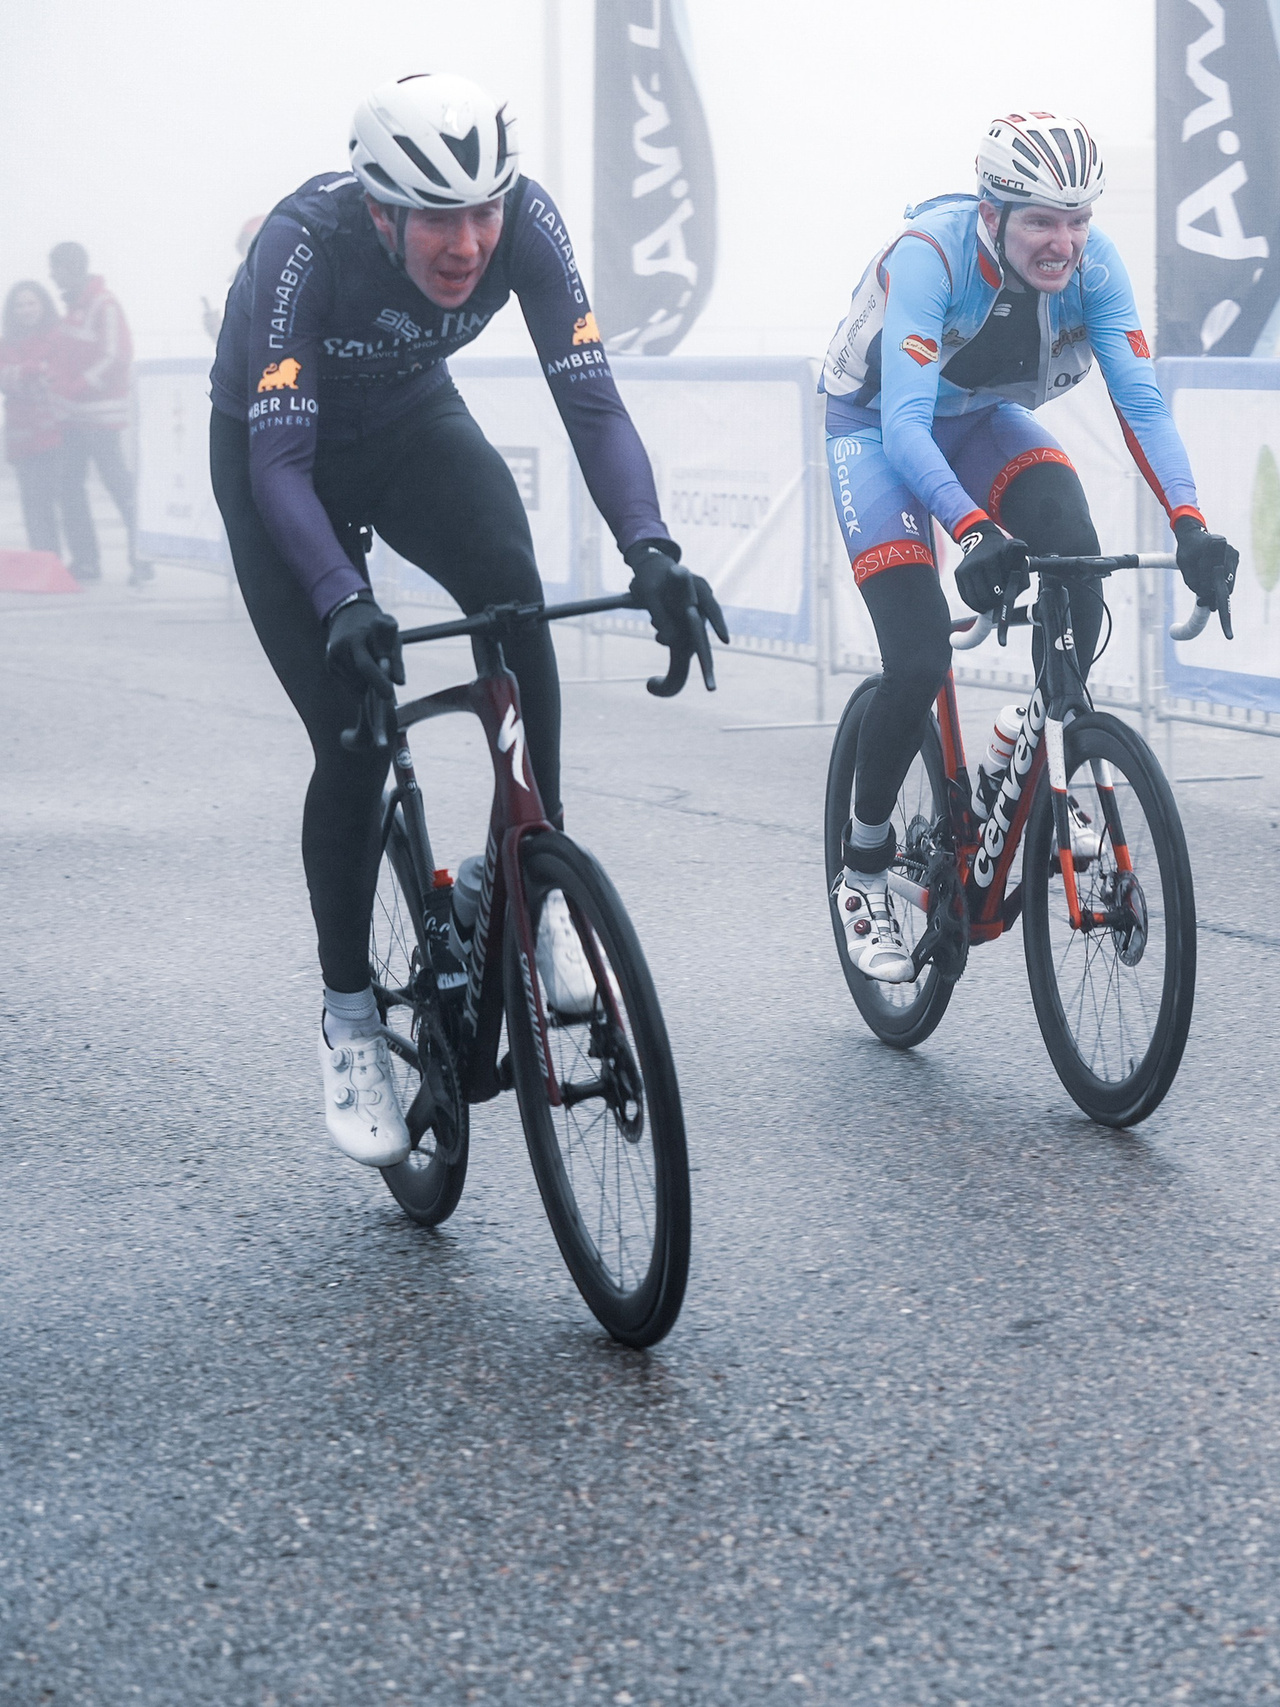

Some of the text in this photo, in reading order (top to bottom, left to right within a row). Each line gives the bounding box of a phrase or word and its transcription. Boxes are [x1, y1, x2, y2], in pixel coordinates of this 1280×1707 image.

[528, 198, 584, 304] ПАНАВТО
[269, 243, 314, 349] ПАНАВТО
[548, 349, 605, 376] AMBER
[290, 396, 319, 415] LIO
[837, 464, 862, 539] GLOCK
[990, 449, 1059, 508] RUSSIA
